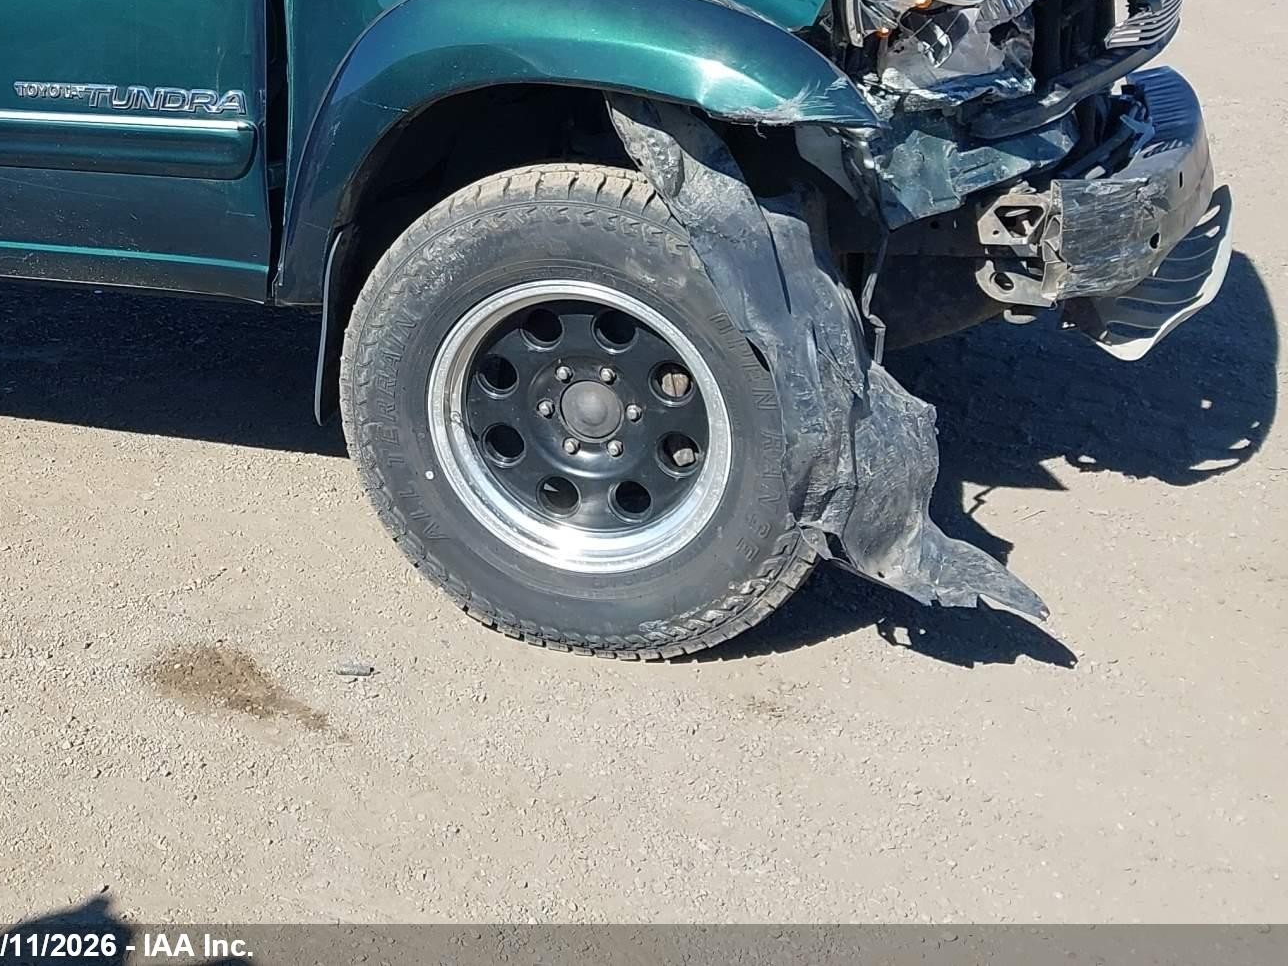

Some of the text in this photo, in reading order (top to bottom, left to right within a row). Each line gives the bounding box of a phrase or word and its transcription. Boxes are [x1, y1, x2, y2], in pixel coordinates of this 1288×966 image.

[14, 81, 247, 115] TOYOTA TUNDRA
[374, 310, 451, 541] ALL TERRAIN
